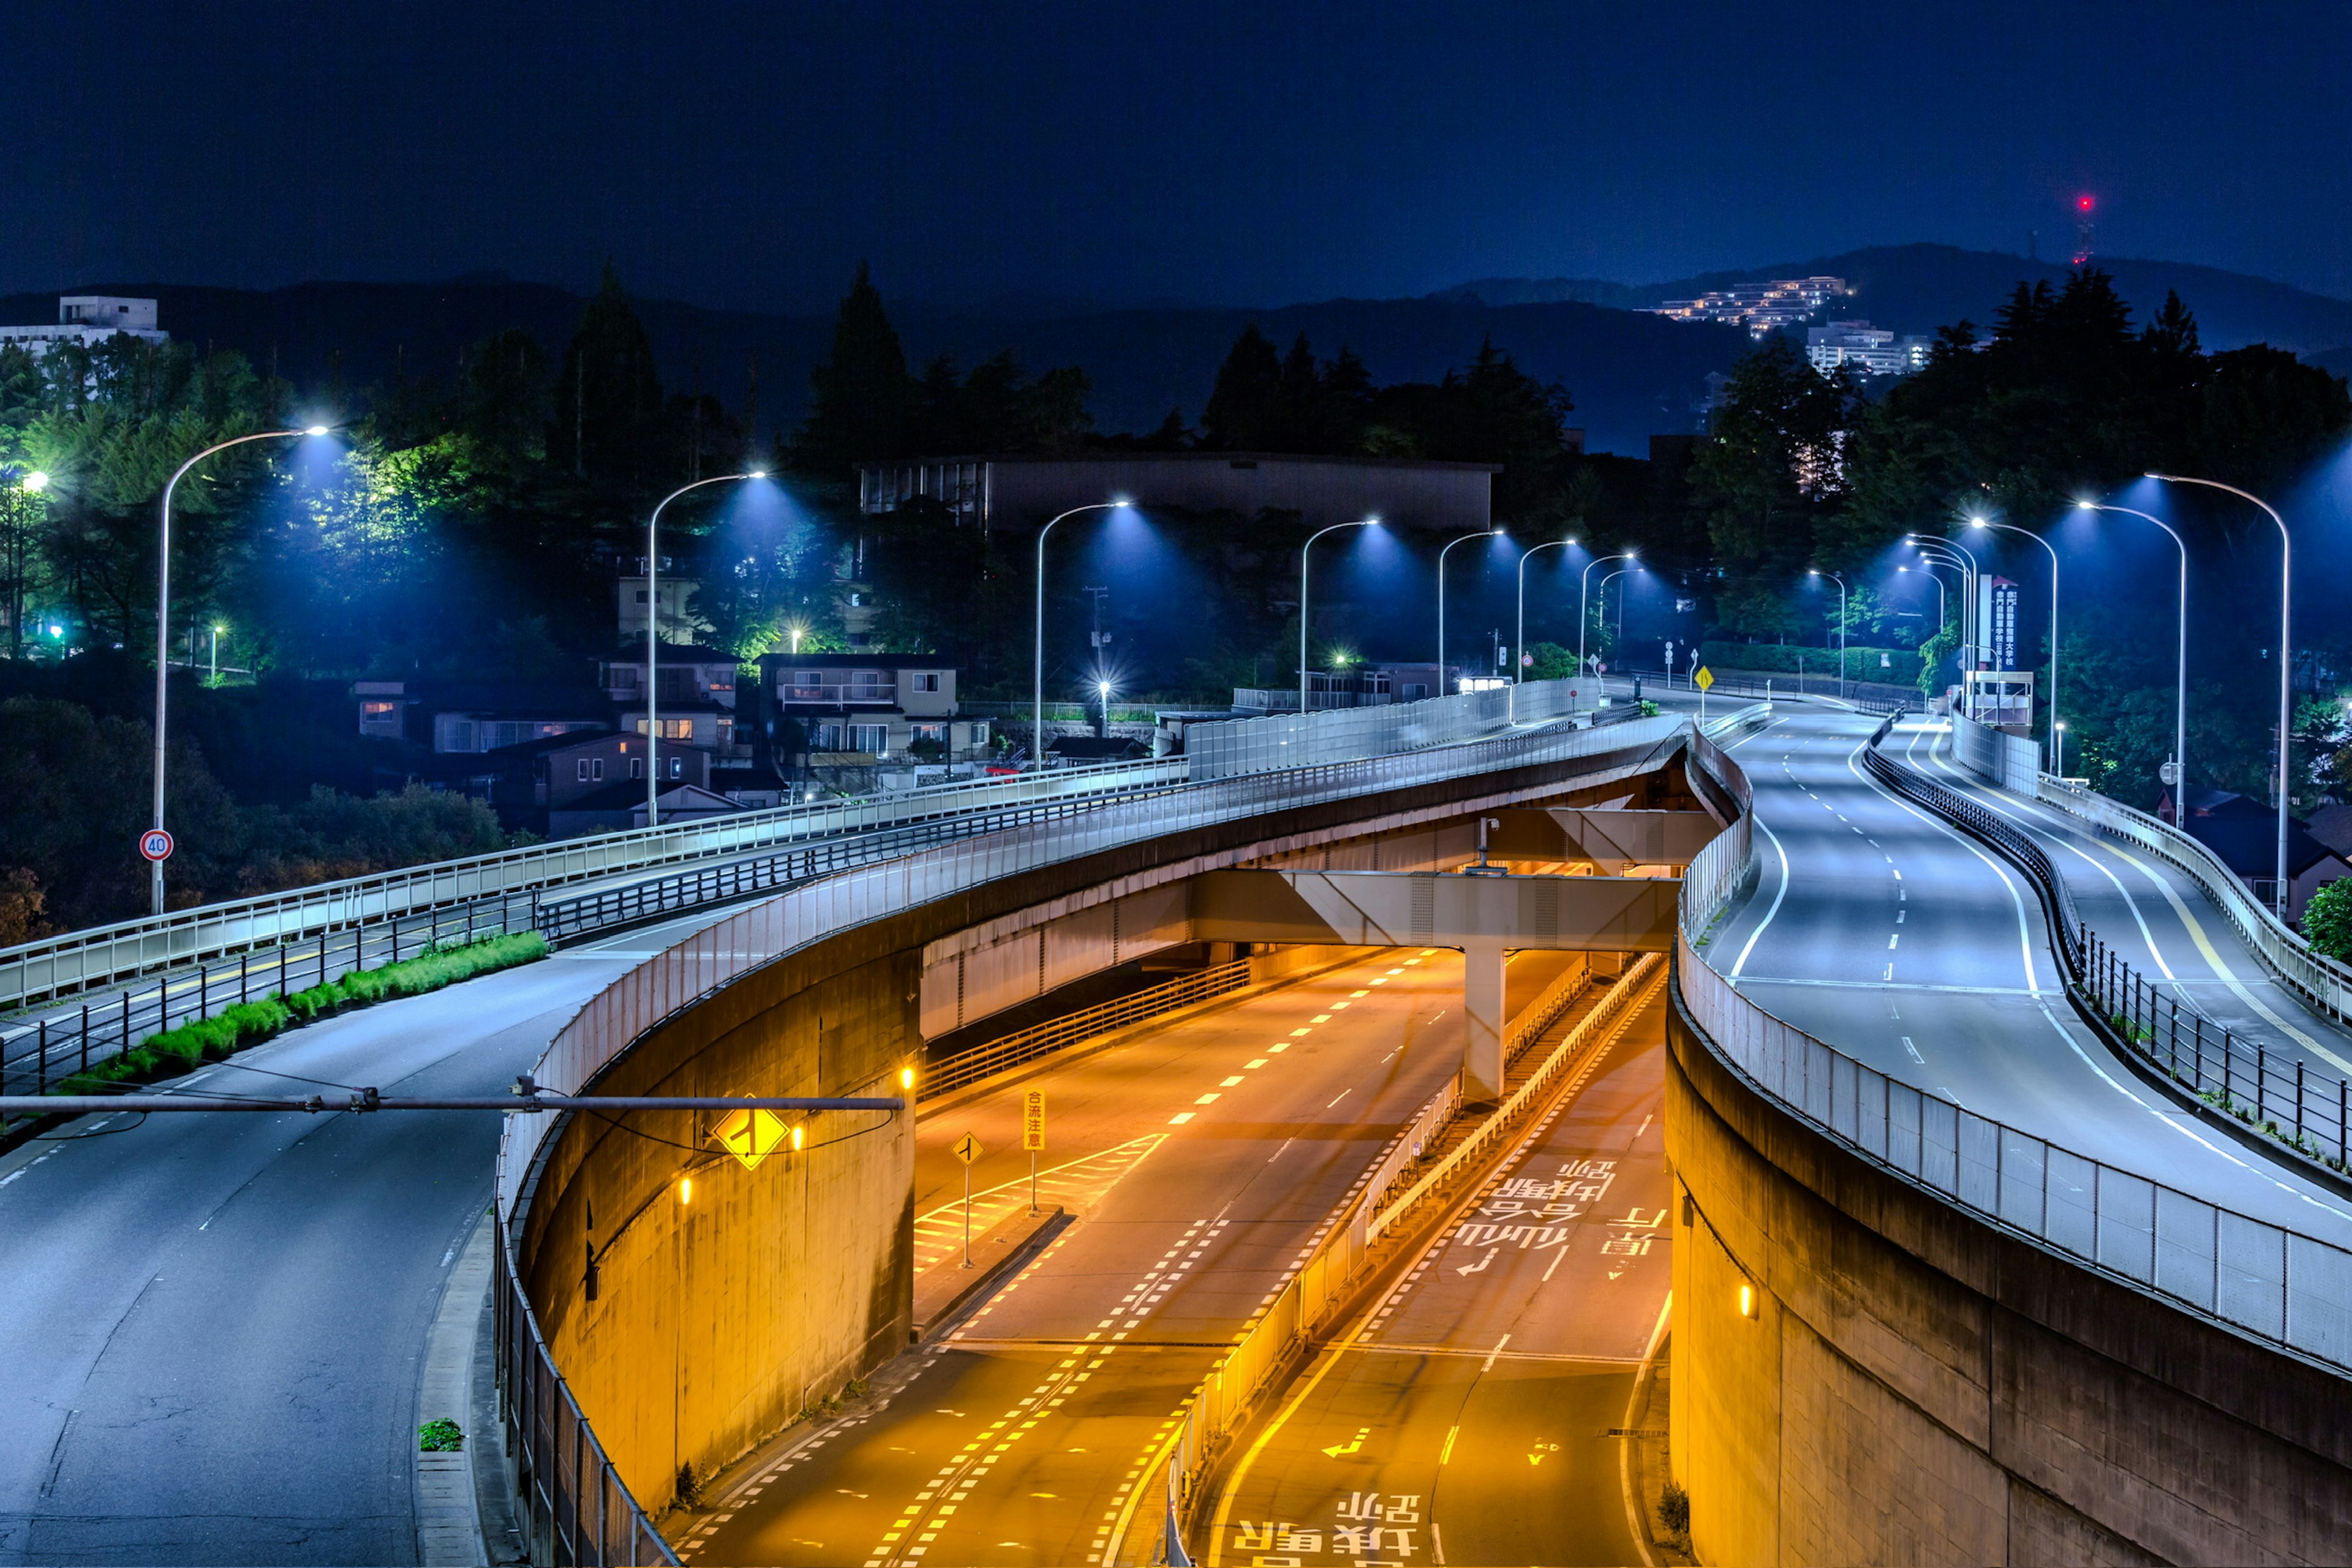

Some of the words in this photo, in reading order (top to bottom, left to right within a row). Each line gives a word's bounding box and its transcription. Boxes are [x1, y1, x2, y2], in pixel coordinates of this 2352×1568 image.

[148, 838, 165, 852] 40
[1028, 1091, 1041, 1147] 合流注意
[1333, 1491, 1420, 1567] 城跡
